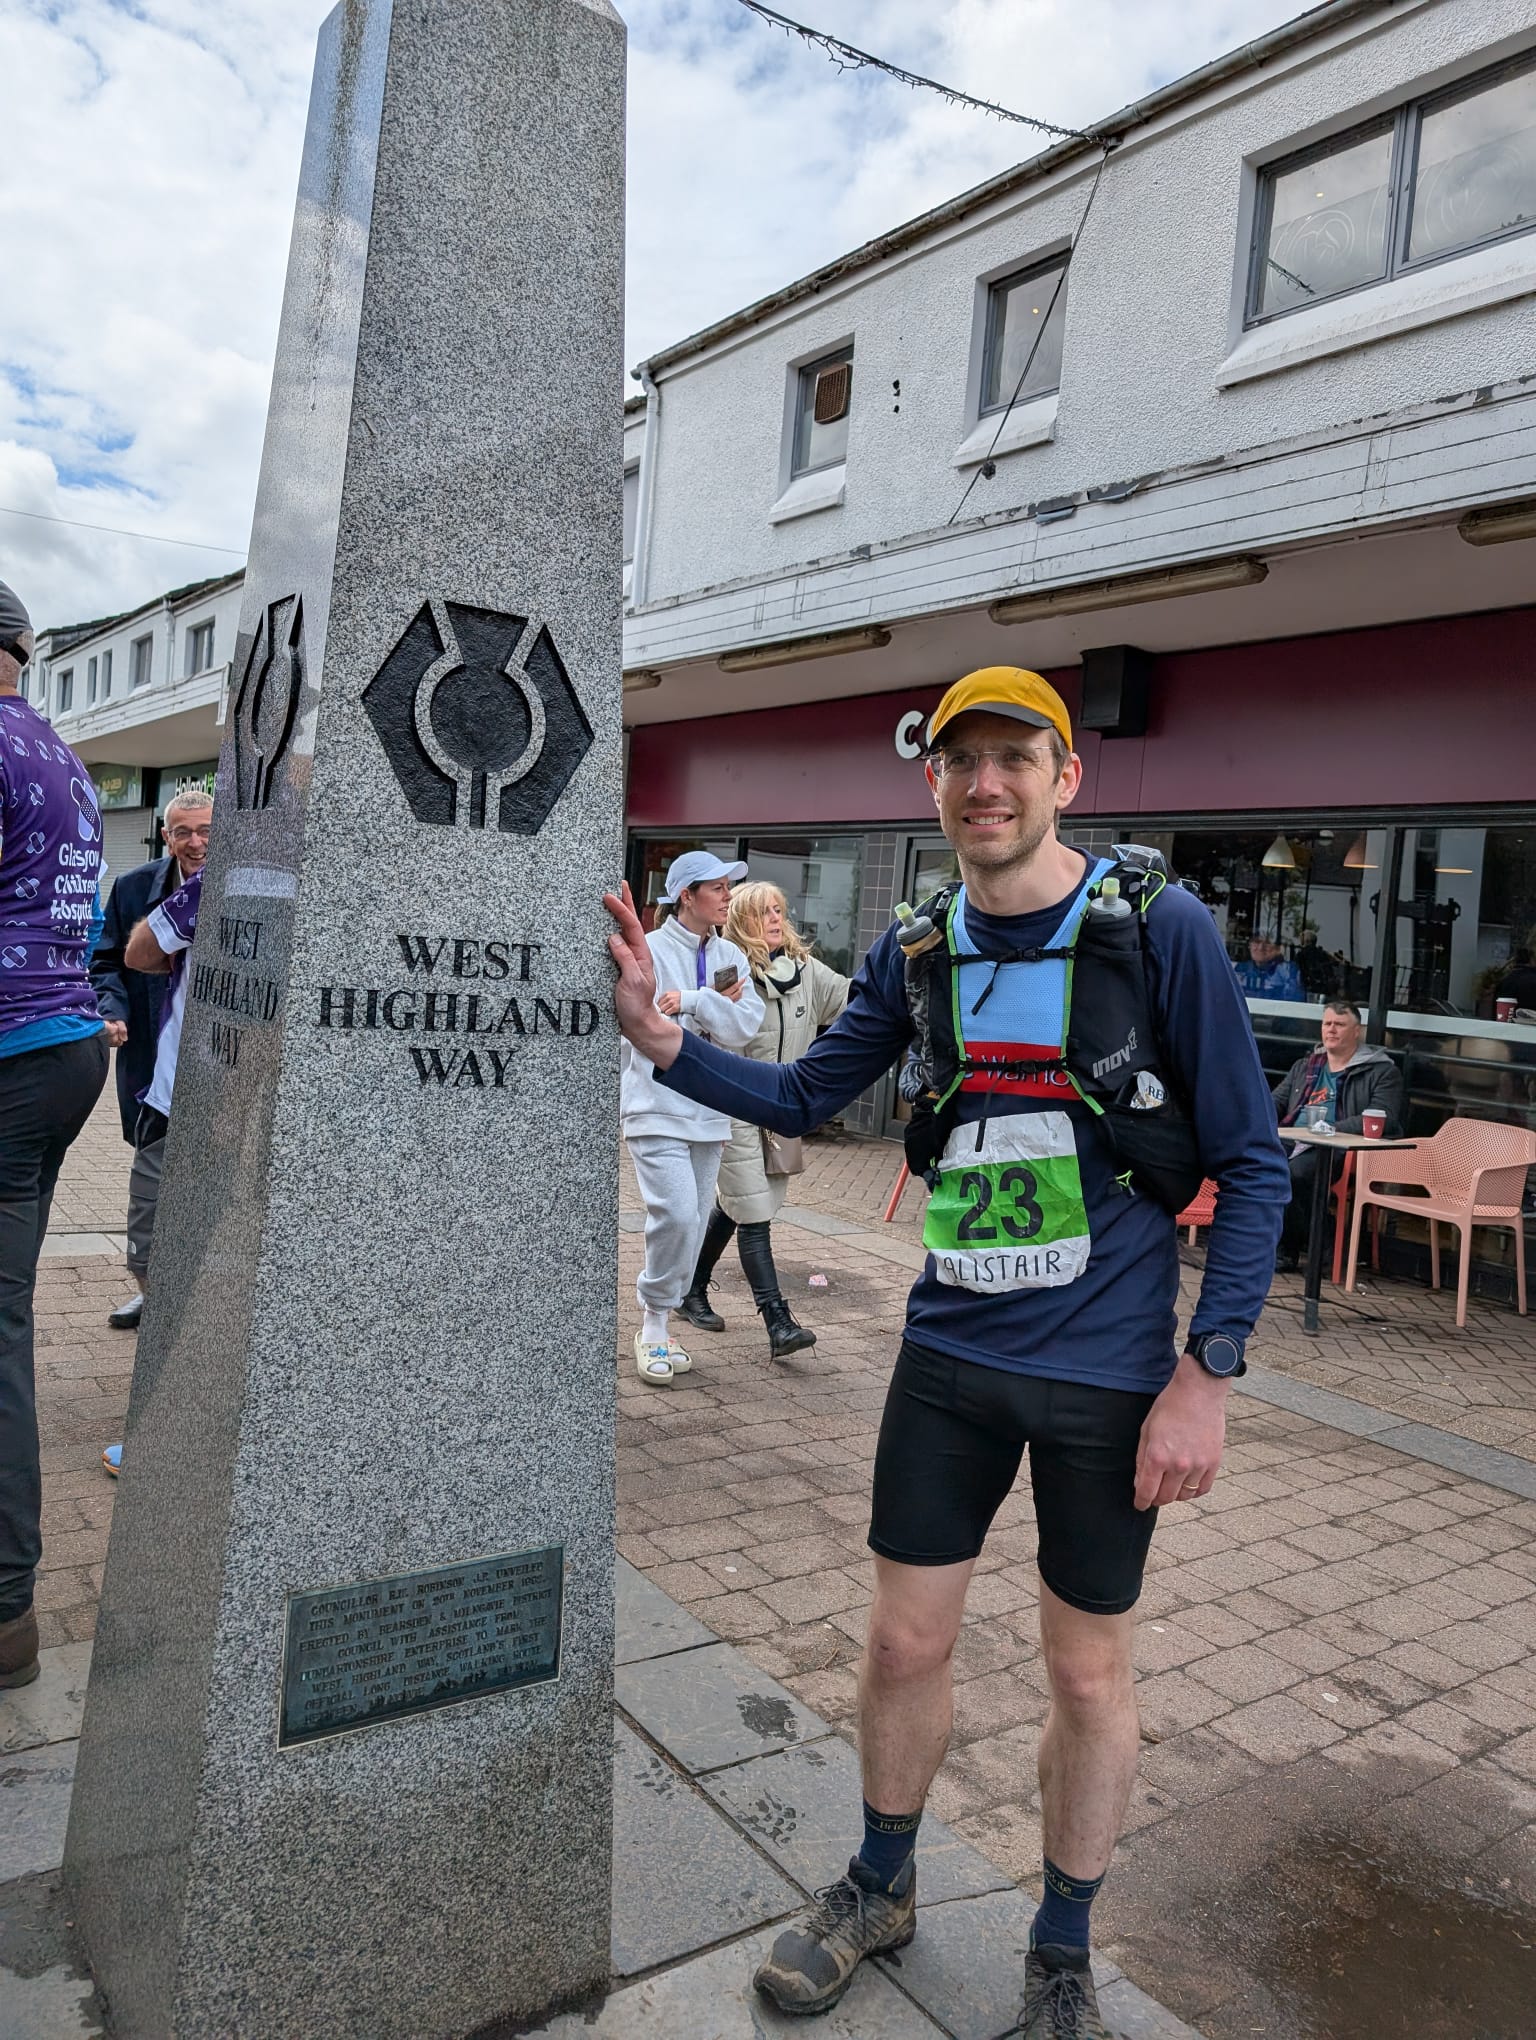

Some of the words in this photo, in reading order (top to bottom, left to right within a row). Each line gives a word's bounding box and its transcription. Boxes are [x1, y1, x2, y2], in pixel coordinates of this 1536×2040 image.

[220, 918, 263, 960] WEST
[396, 934, 541, 982] WEST
[193, 964, 278, 1021] HIGHLAND
[316, 987, 600, 1036] HIGHLAND
[212, 1022, 246, 1068] WAY
[409, 1047, 521, 1088] WAY
[957, 1167, 1044, 1241] 23
[943, 1250, 1061, 1282] ALISTAIR
[308, 1617, 334, 1631] THIS
[439, 1611, 446, 1621] &
[475, 1629, 487, 1641] TO
